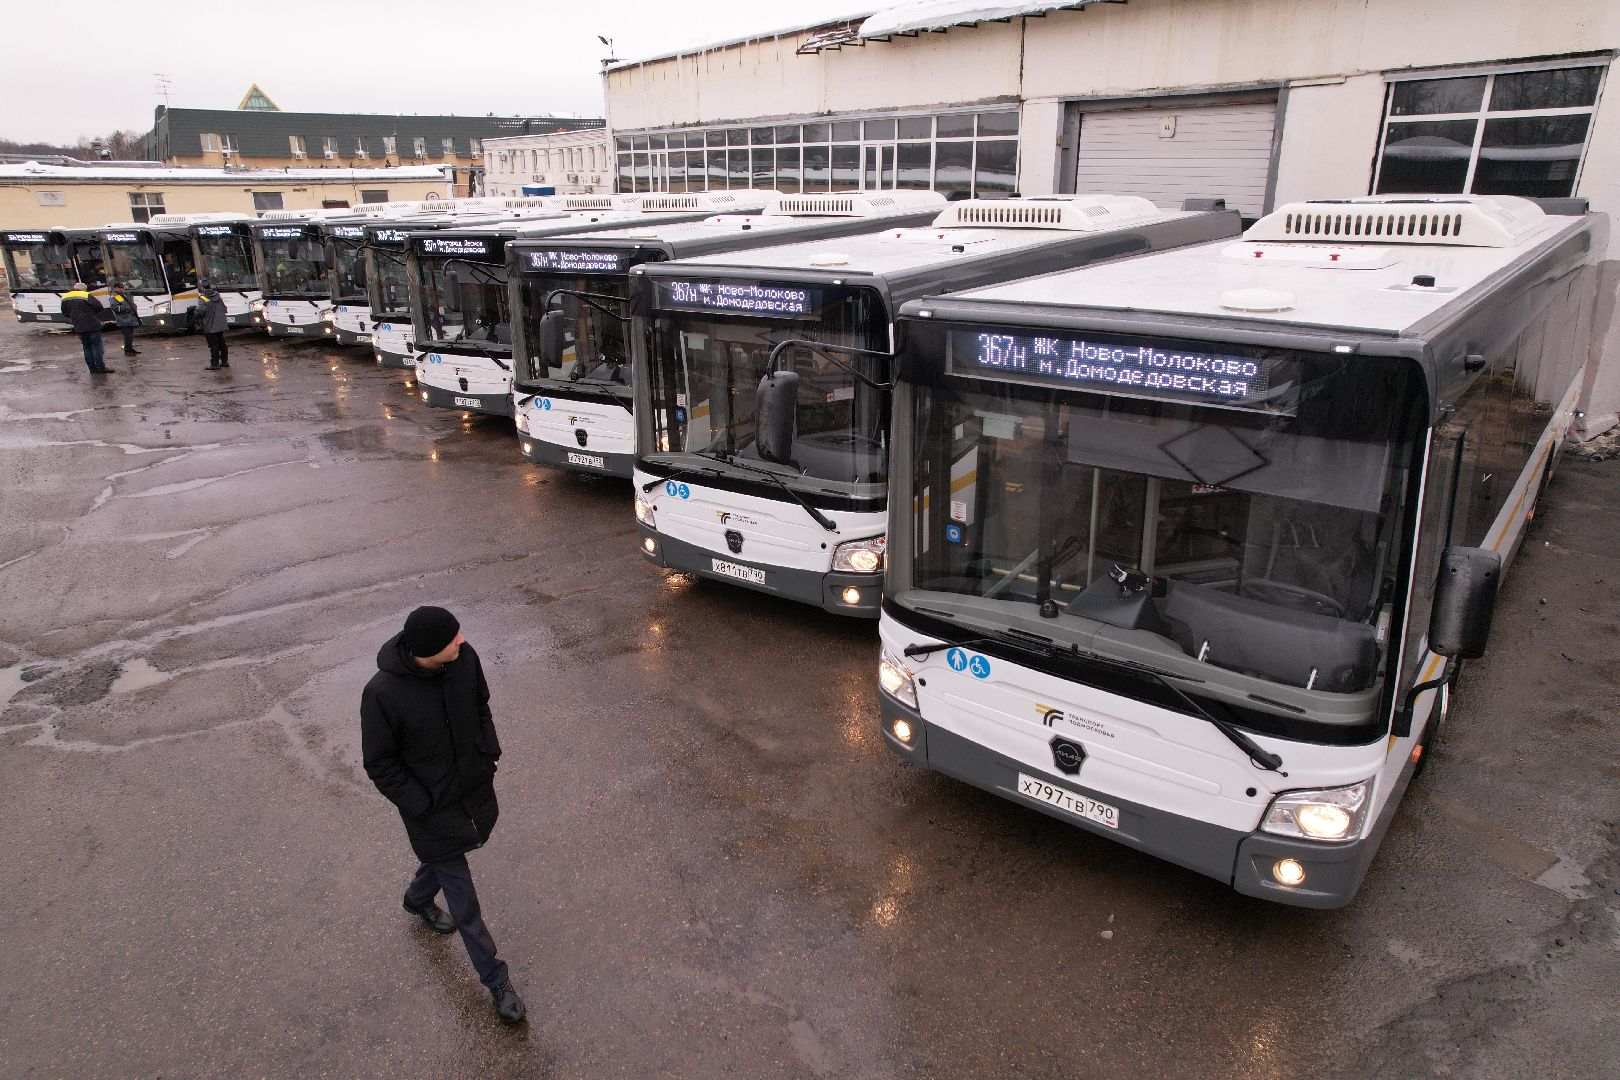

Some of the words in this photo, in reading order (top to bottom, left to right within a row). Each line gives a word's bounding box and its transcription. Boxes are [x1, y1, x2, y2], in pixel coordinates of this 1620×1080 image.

[560, 251, 618, 262] Ново-Молоково
[699, 283, 713, 295] ЖК
[718, 284, 805, 301] Ново-Молоково
[703, 295, 803, 313] м.Домодедовская
[1034, 337, 1059, 356] ЖК
[1072, 340, 1258, 377] Ново-Молоково
[1040, 358, 1248, 397] м.Домодедовская
[1068, 713, 1104, 728] ТРАНСПОРТ
[1069, 719, 1115, 738] ПОДМОСКОВЬЯ
